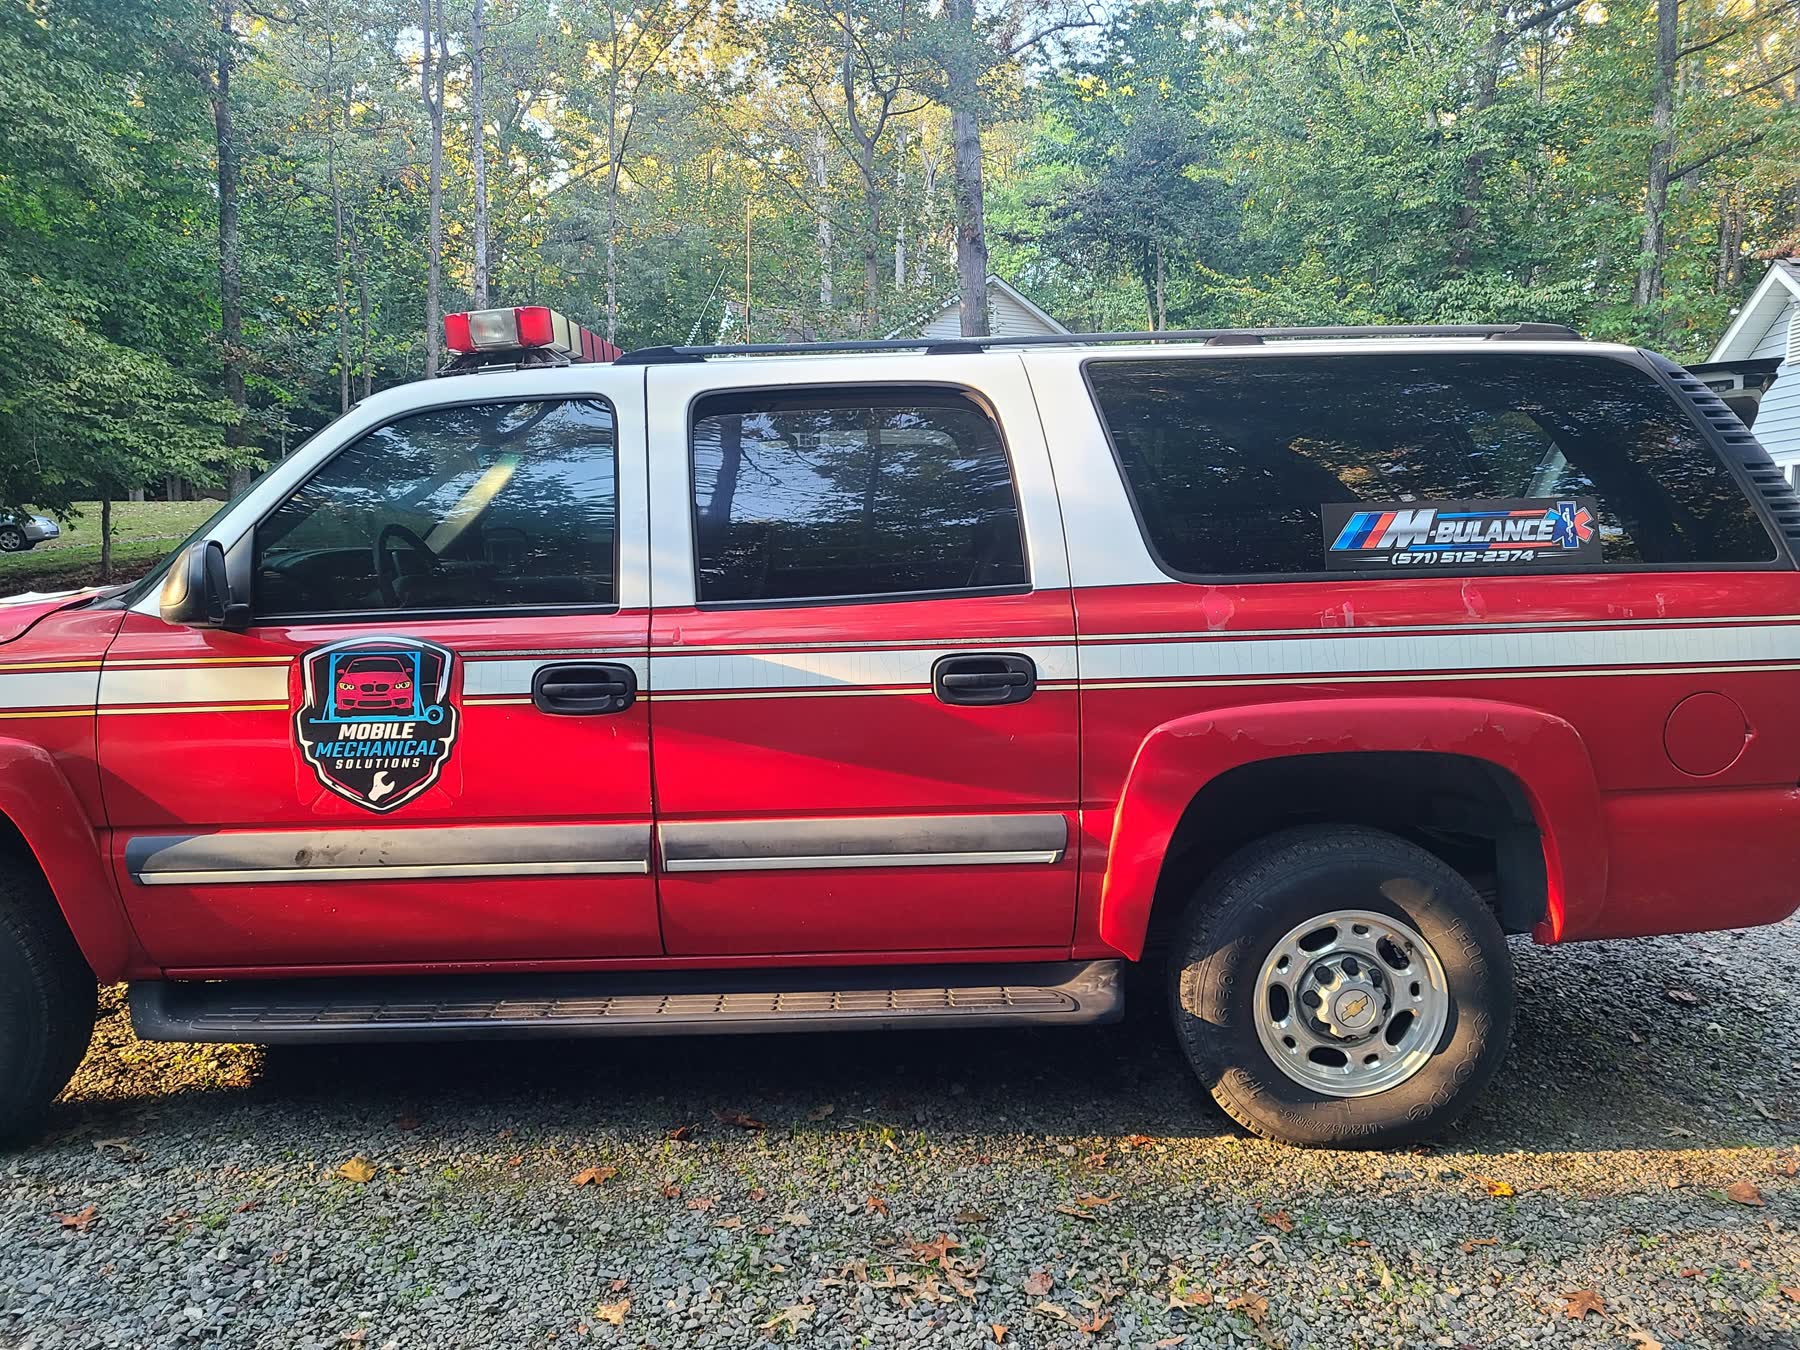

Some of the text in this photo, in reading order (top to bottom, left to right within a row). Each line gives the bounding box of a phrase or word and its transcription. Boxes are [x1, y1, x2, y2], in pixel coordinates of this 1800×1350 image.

[1376, 508, 1555, 549] M-BULANCE
[1391, 550, 1535, 566] (571) 512-2374
[338, 722, 416, 740] MOBILE
[314, 740, 439, 758] MECHANICAL
[335, 758, 420, 769] SOLUTIONS
